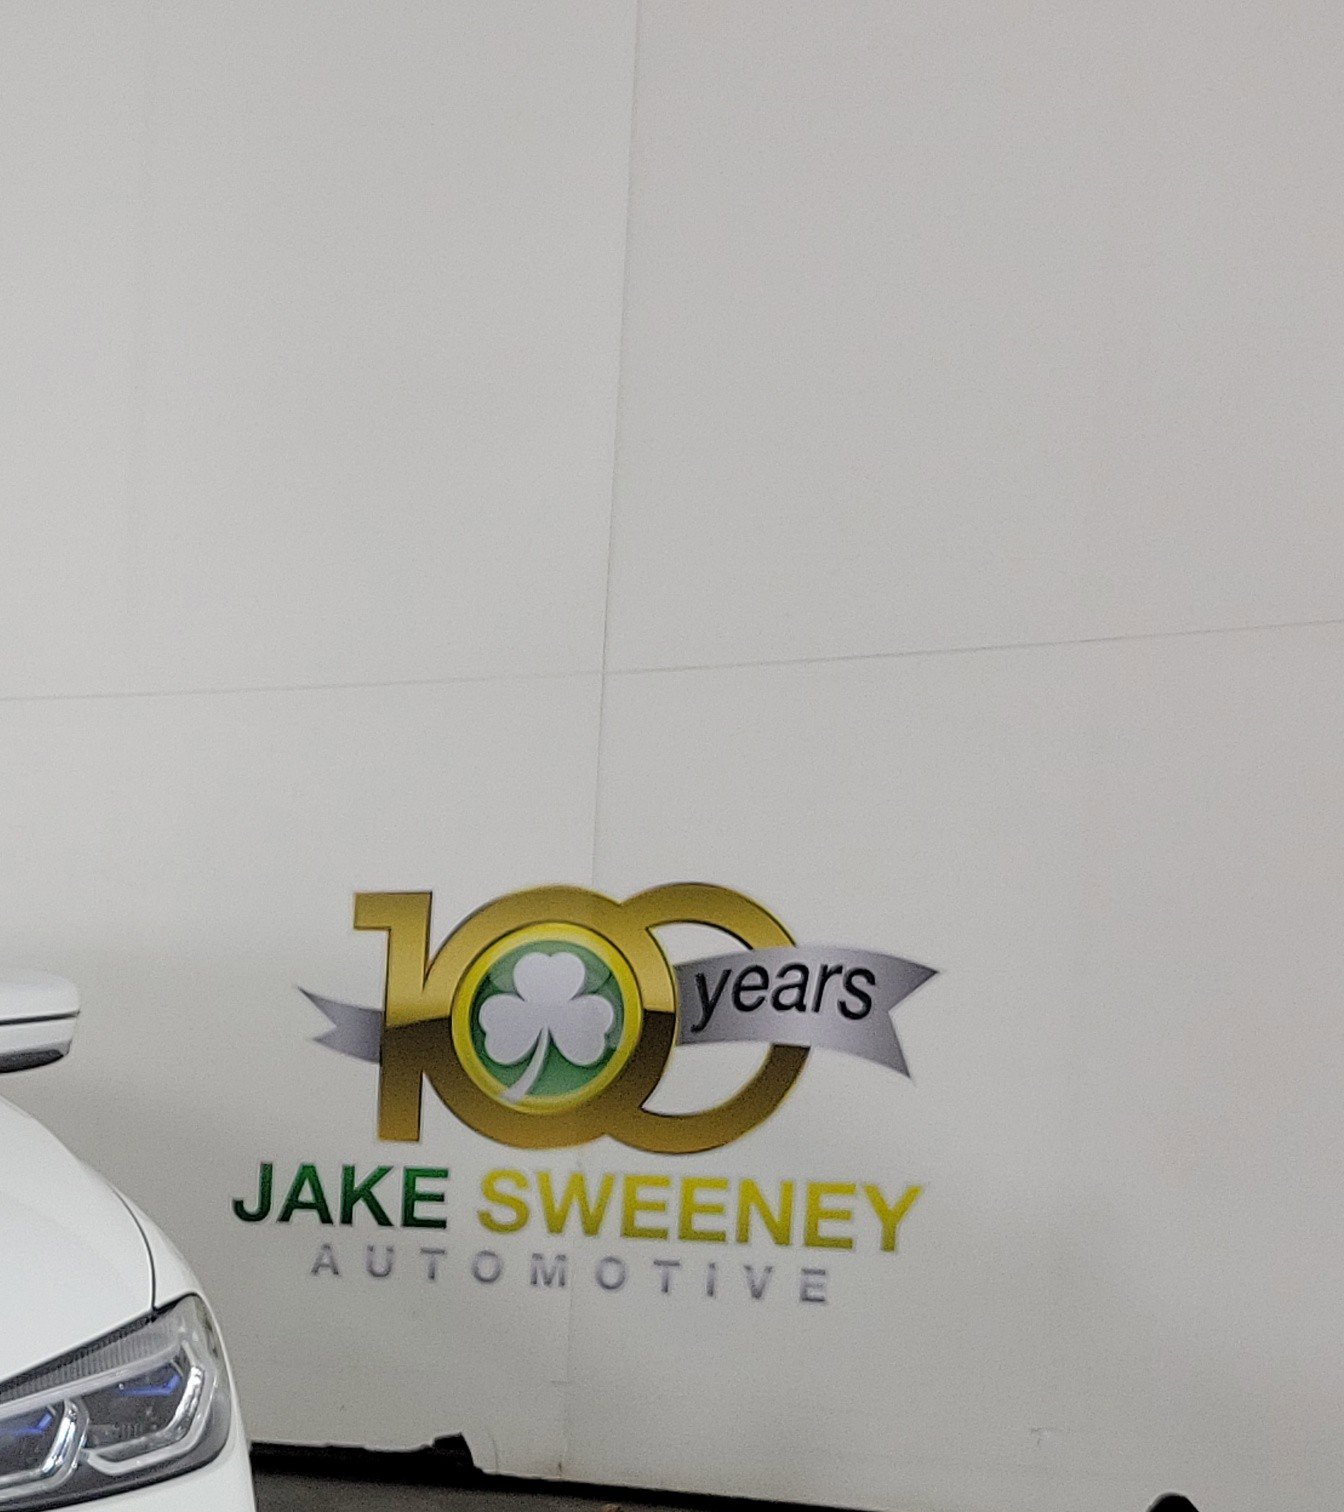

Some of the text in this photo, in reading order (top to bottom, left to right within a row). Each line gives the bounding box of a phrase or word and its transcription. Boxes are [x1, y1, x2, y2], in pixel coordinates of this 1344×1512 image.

[353, 882, 878, 1155] 100 years
[232, 1162, 923, 1253] JAKE SWEENEY
[311, 1243, 830, 1304] AUTOMOTIVE
